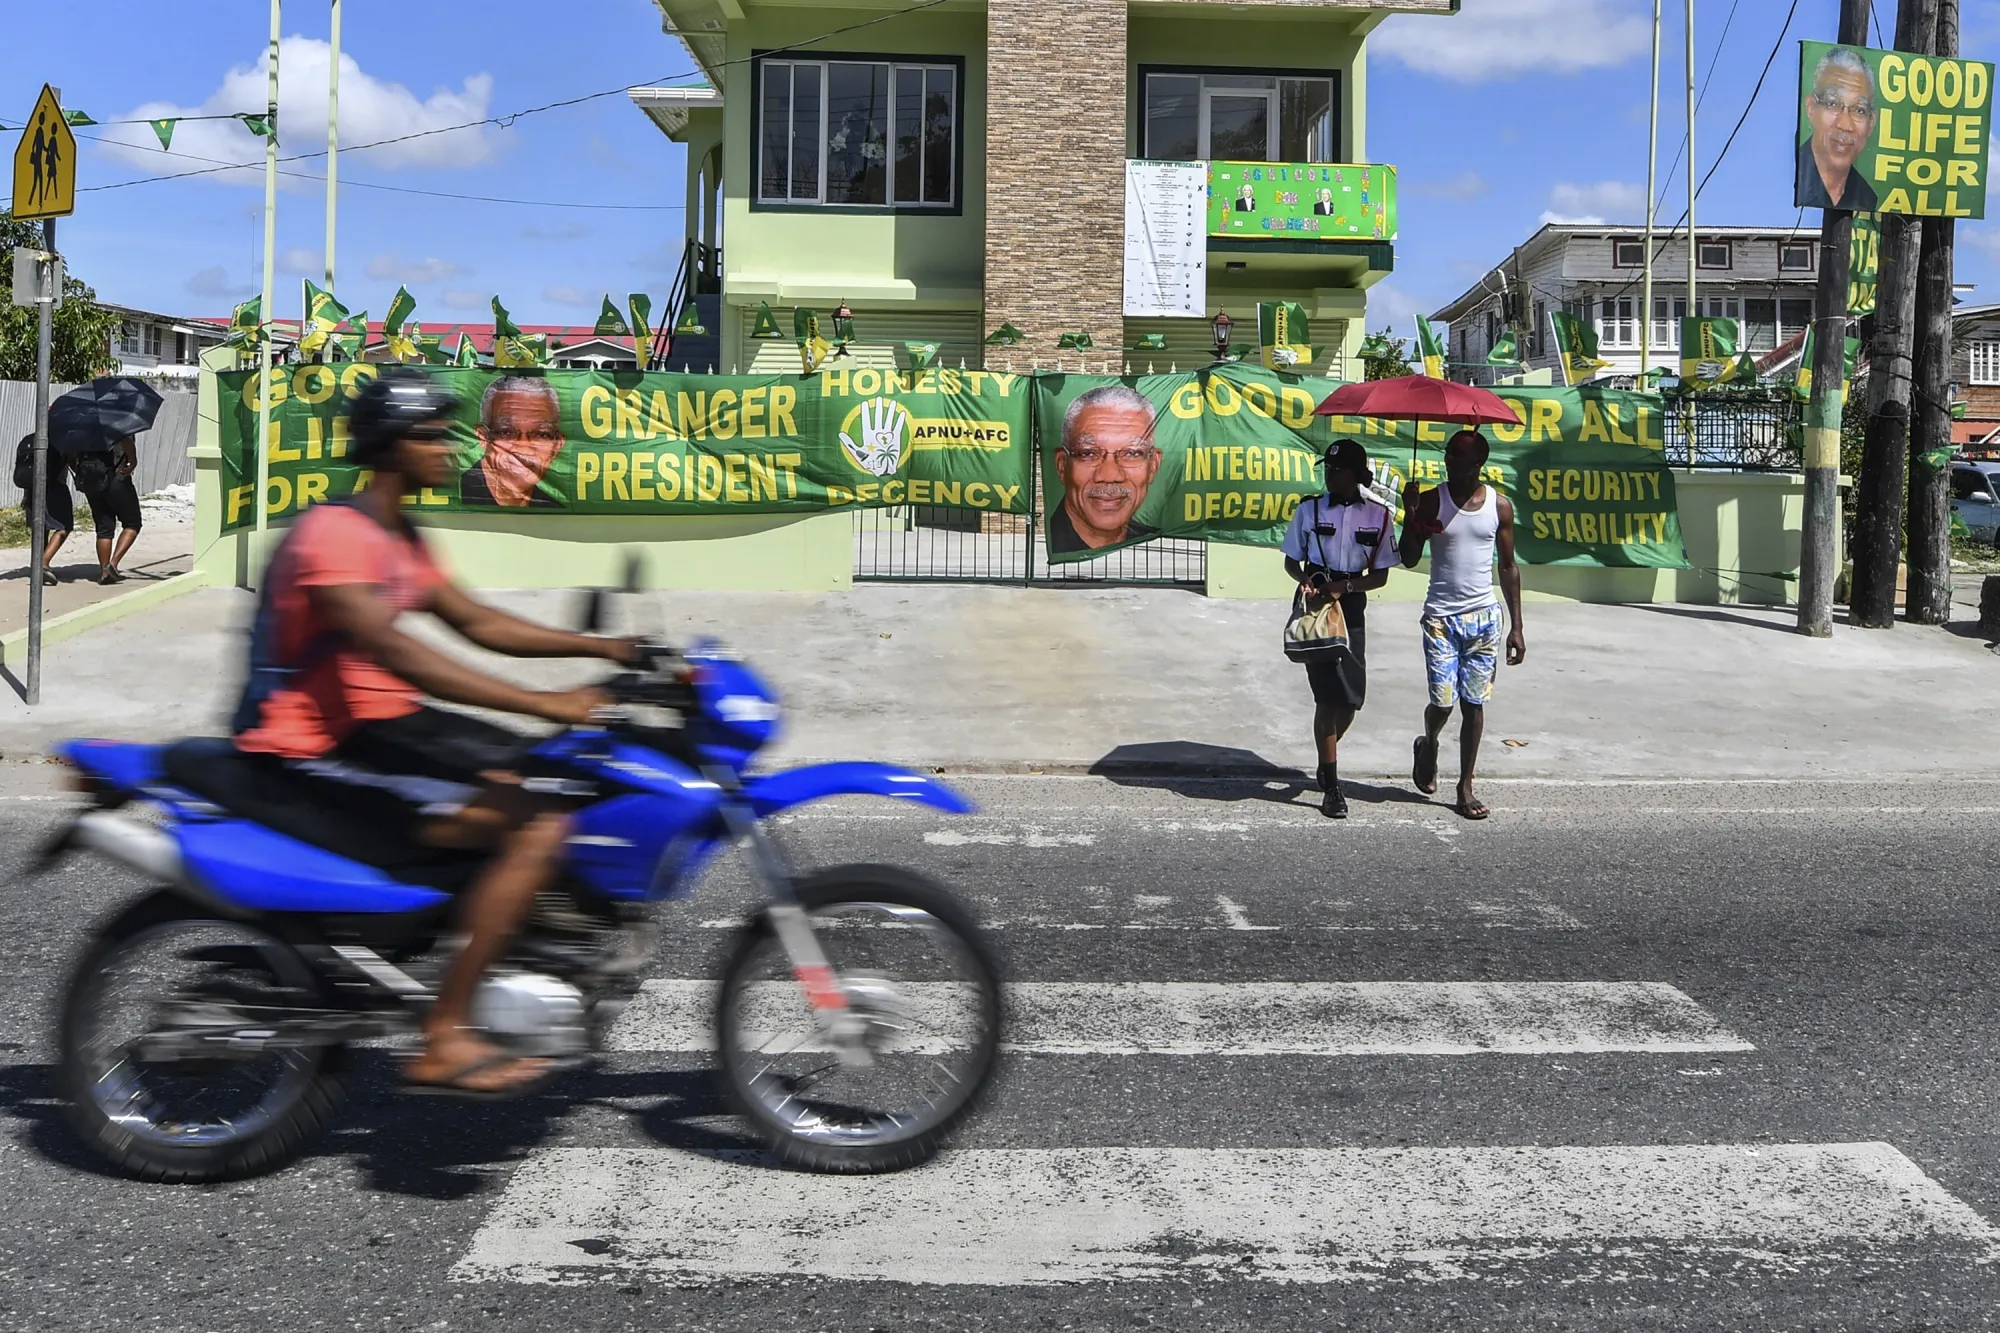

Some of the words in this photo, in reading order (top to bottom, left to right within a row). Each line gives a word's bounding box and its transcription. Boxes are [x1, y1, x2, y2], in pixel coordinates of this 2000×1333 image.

[1879, 54, 1988, 109] GOOD
[1878, 108, 1982, 154] LIFE
[1242, 167, 1343, 183] AGRICOLA
[1874, 154, 1979, 186] FOR
[1878, 187, 1971, 216] ALL
[242, 363, 383, 412] GOO
[820, 368, 1018, 398] HONESTY
[580, 384, 798, 441] GRANGER
[1169, 374, 1316, 429] GOOD
[1463, 398, 1563, 443] OR
[1577, 399, 1664, 451] ALL
[914, 426, 1008, 442] APNU+AFC
[576, 452, 801, 502] PRESIDENT
[1185, 445, 1318, 482] INTEGRITY
[226, 472, 330, 526] FOR
[826, 479, 1020, 510] DECENCY
[1528, 468, 1661, 501] SECURITY
[1184, 491, 1302, 522] DECENC
[1532, 510, 1667, 545] STABILITY
